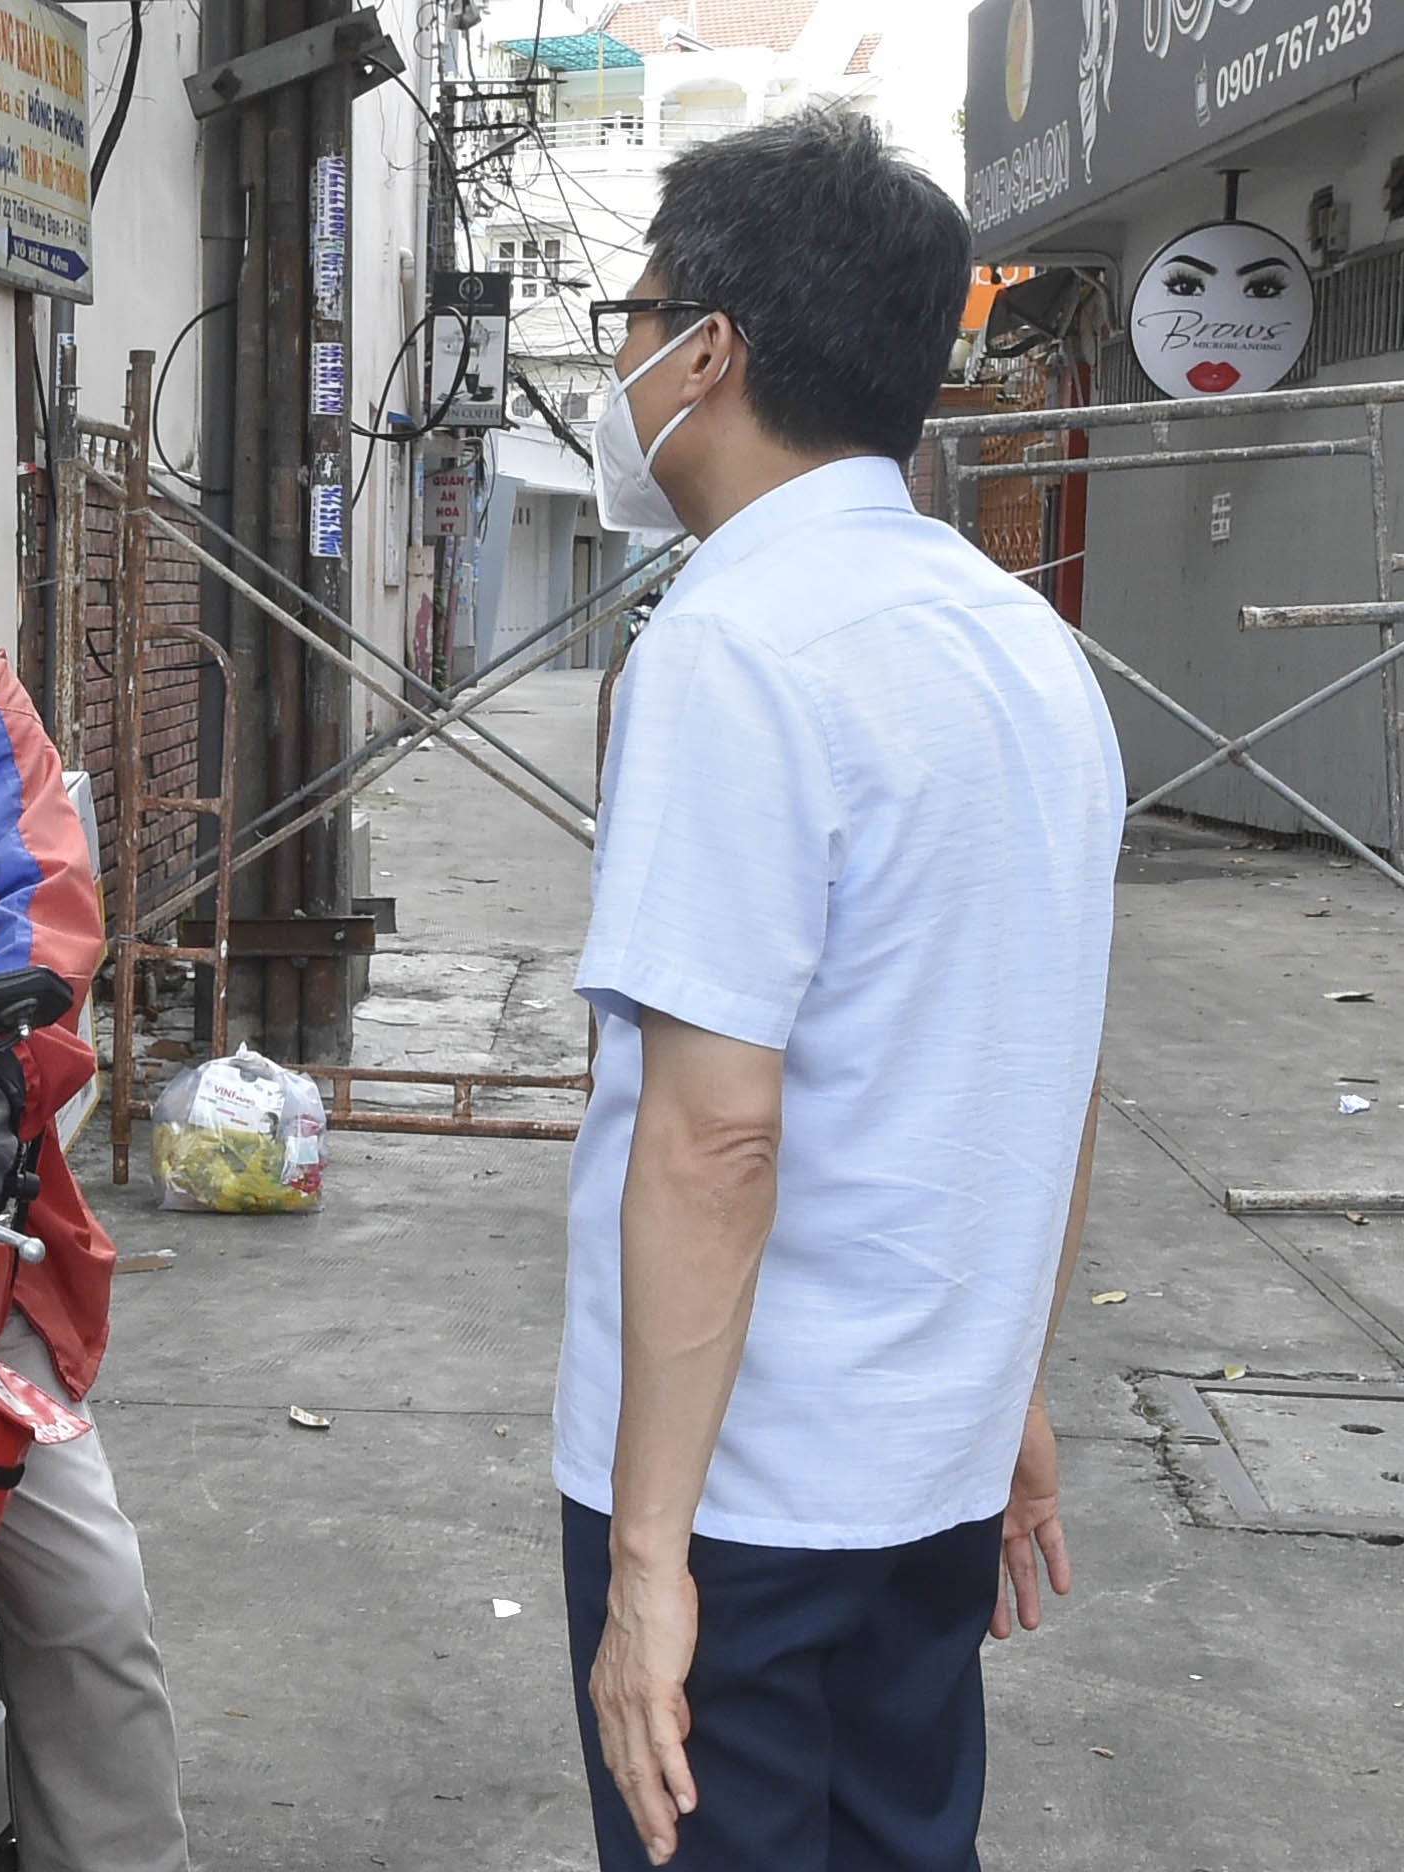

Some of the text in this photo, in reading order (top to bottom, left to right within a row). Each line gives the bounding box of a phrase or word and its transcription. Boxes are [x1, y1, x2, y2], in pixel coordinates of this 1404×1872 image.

[1216, 0, 1372, 108] 0907.767.323
[1137, 309, 1293, 352] Brows
[436, 506, 459, 518] HOA
